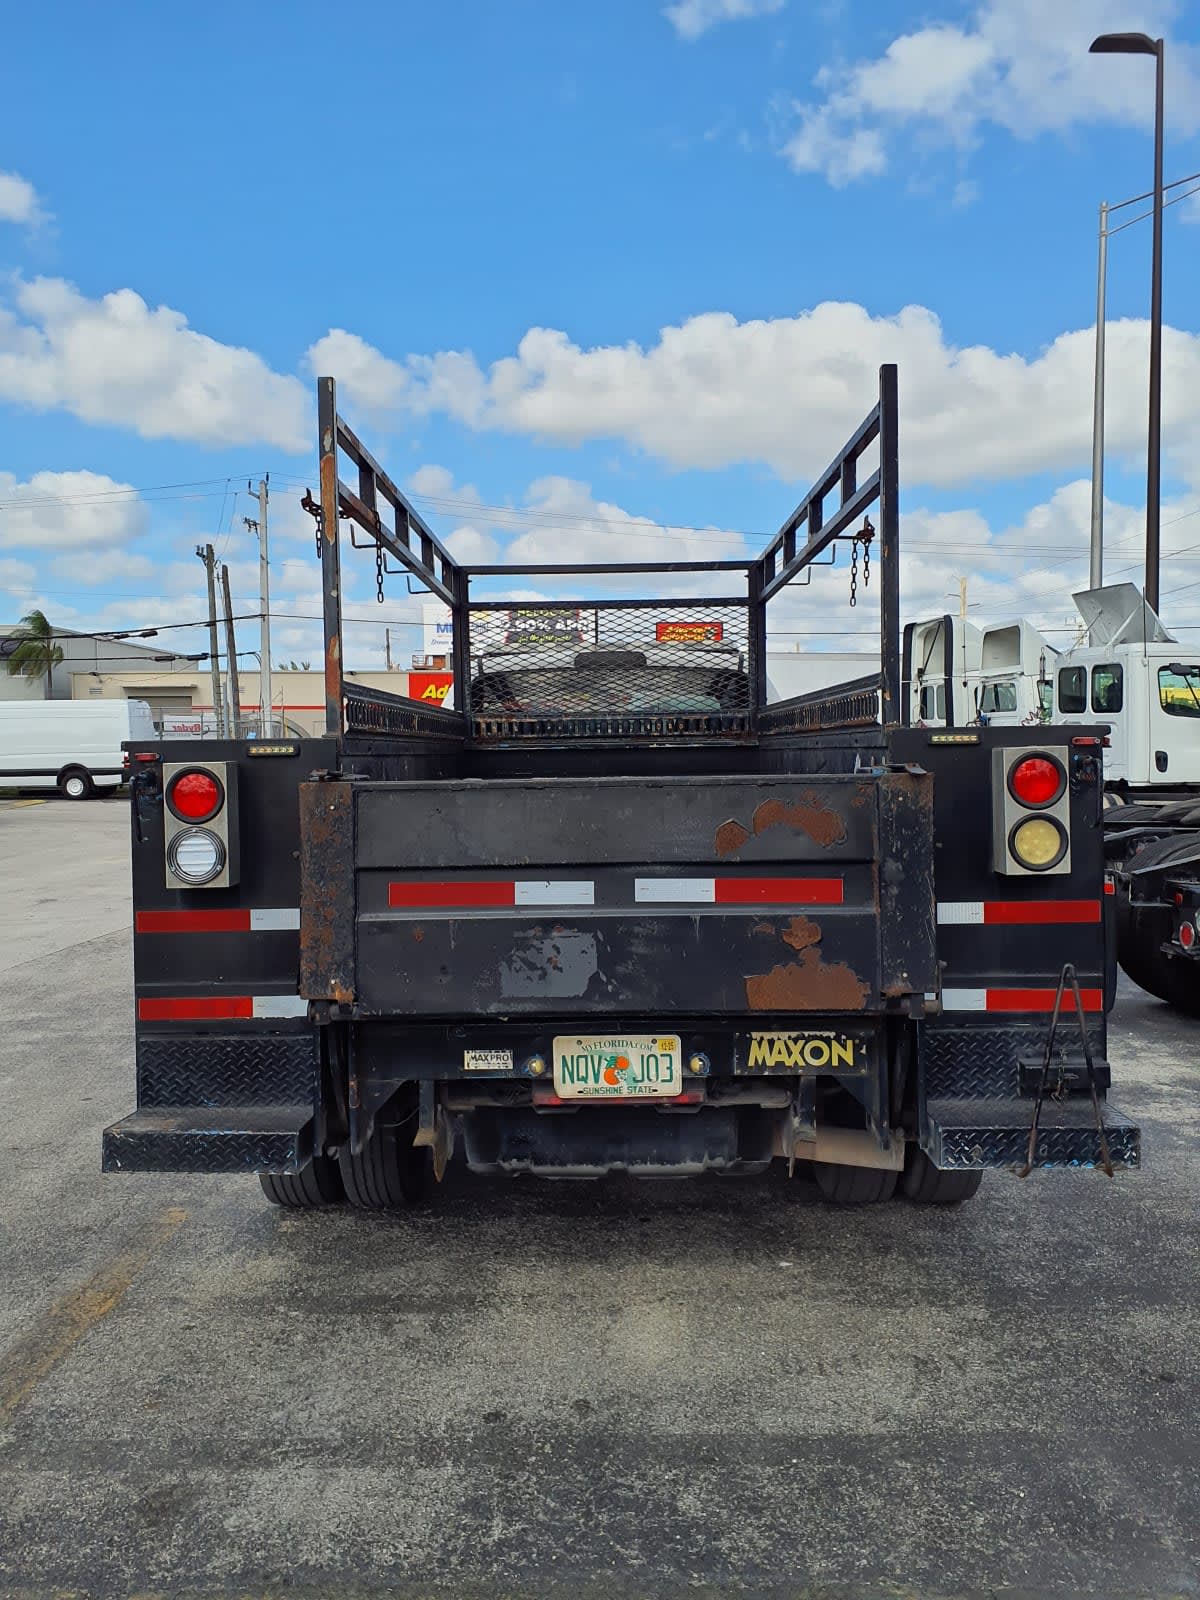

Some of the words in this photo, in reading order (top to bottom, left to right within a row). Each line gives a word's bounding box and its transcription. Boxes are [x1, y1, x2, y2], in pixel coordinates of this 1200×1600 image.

[747, 1039, 854, 1067] MAXON
[561, 1054, 602, 1085] NQV
[583, 1086, 623, 1095] SUNSHINE
[627, 1085, 653, 1094] STATE
